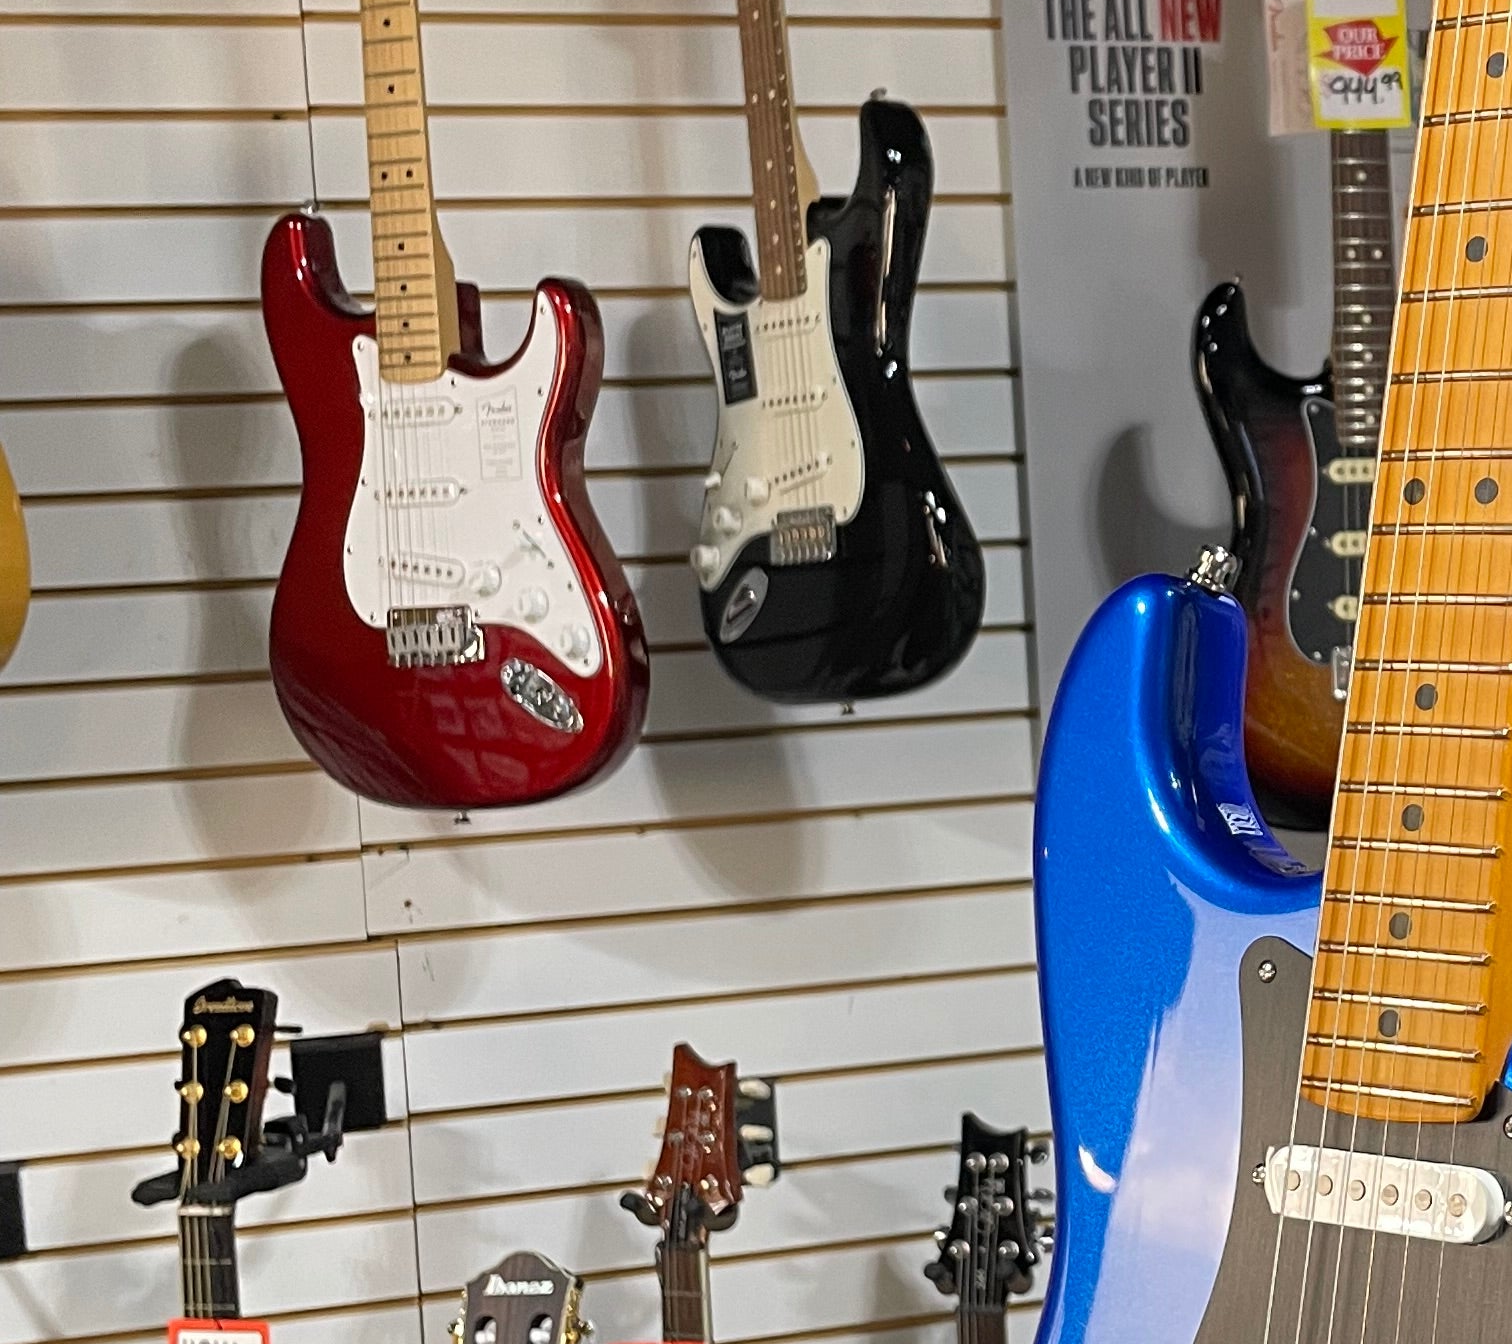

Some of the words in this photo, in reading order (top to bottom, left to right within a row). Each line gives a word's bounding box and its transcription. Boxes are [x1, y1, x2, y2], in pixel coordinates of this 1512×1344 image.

[1338, 27, 1379, 44] OUR
[1333, 42, 1385, 61] PRICE
[1069, 45, 1176, 94] PLAYER
[1182, 47, 1203, 94] II
[1088, 98, 1191, 147] SERIES
[482, 1274, 555, 1297] Ibanez
